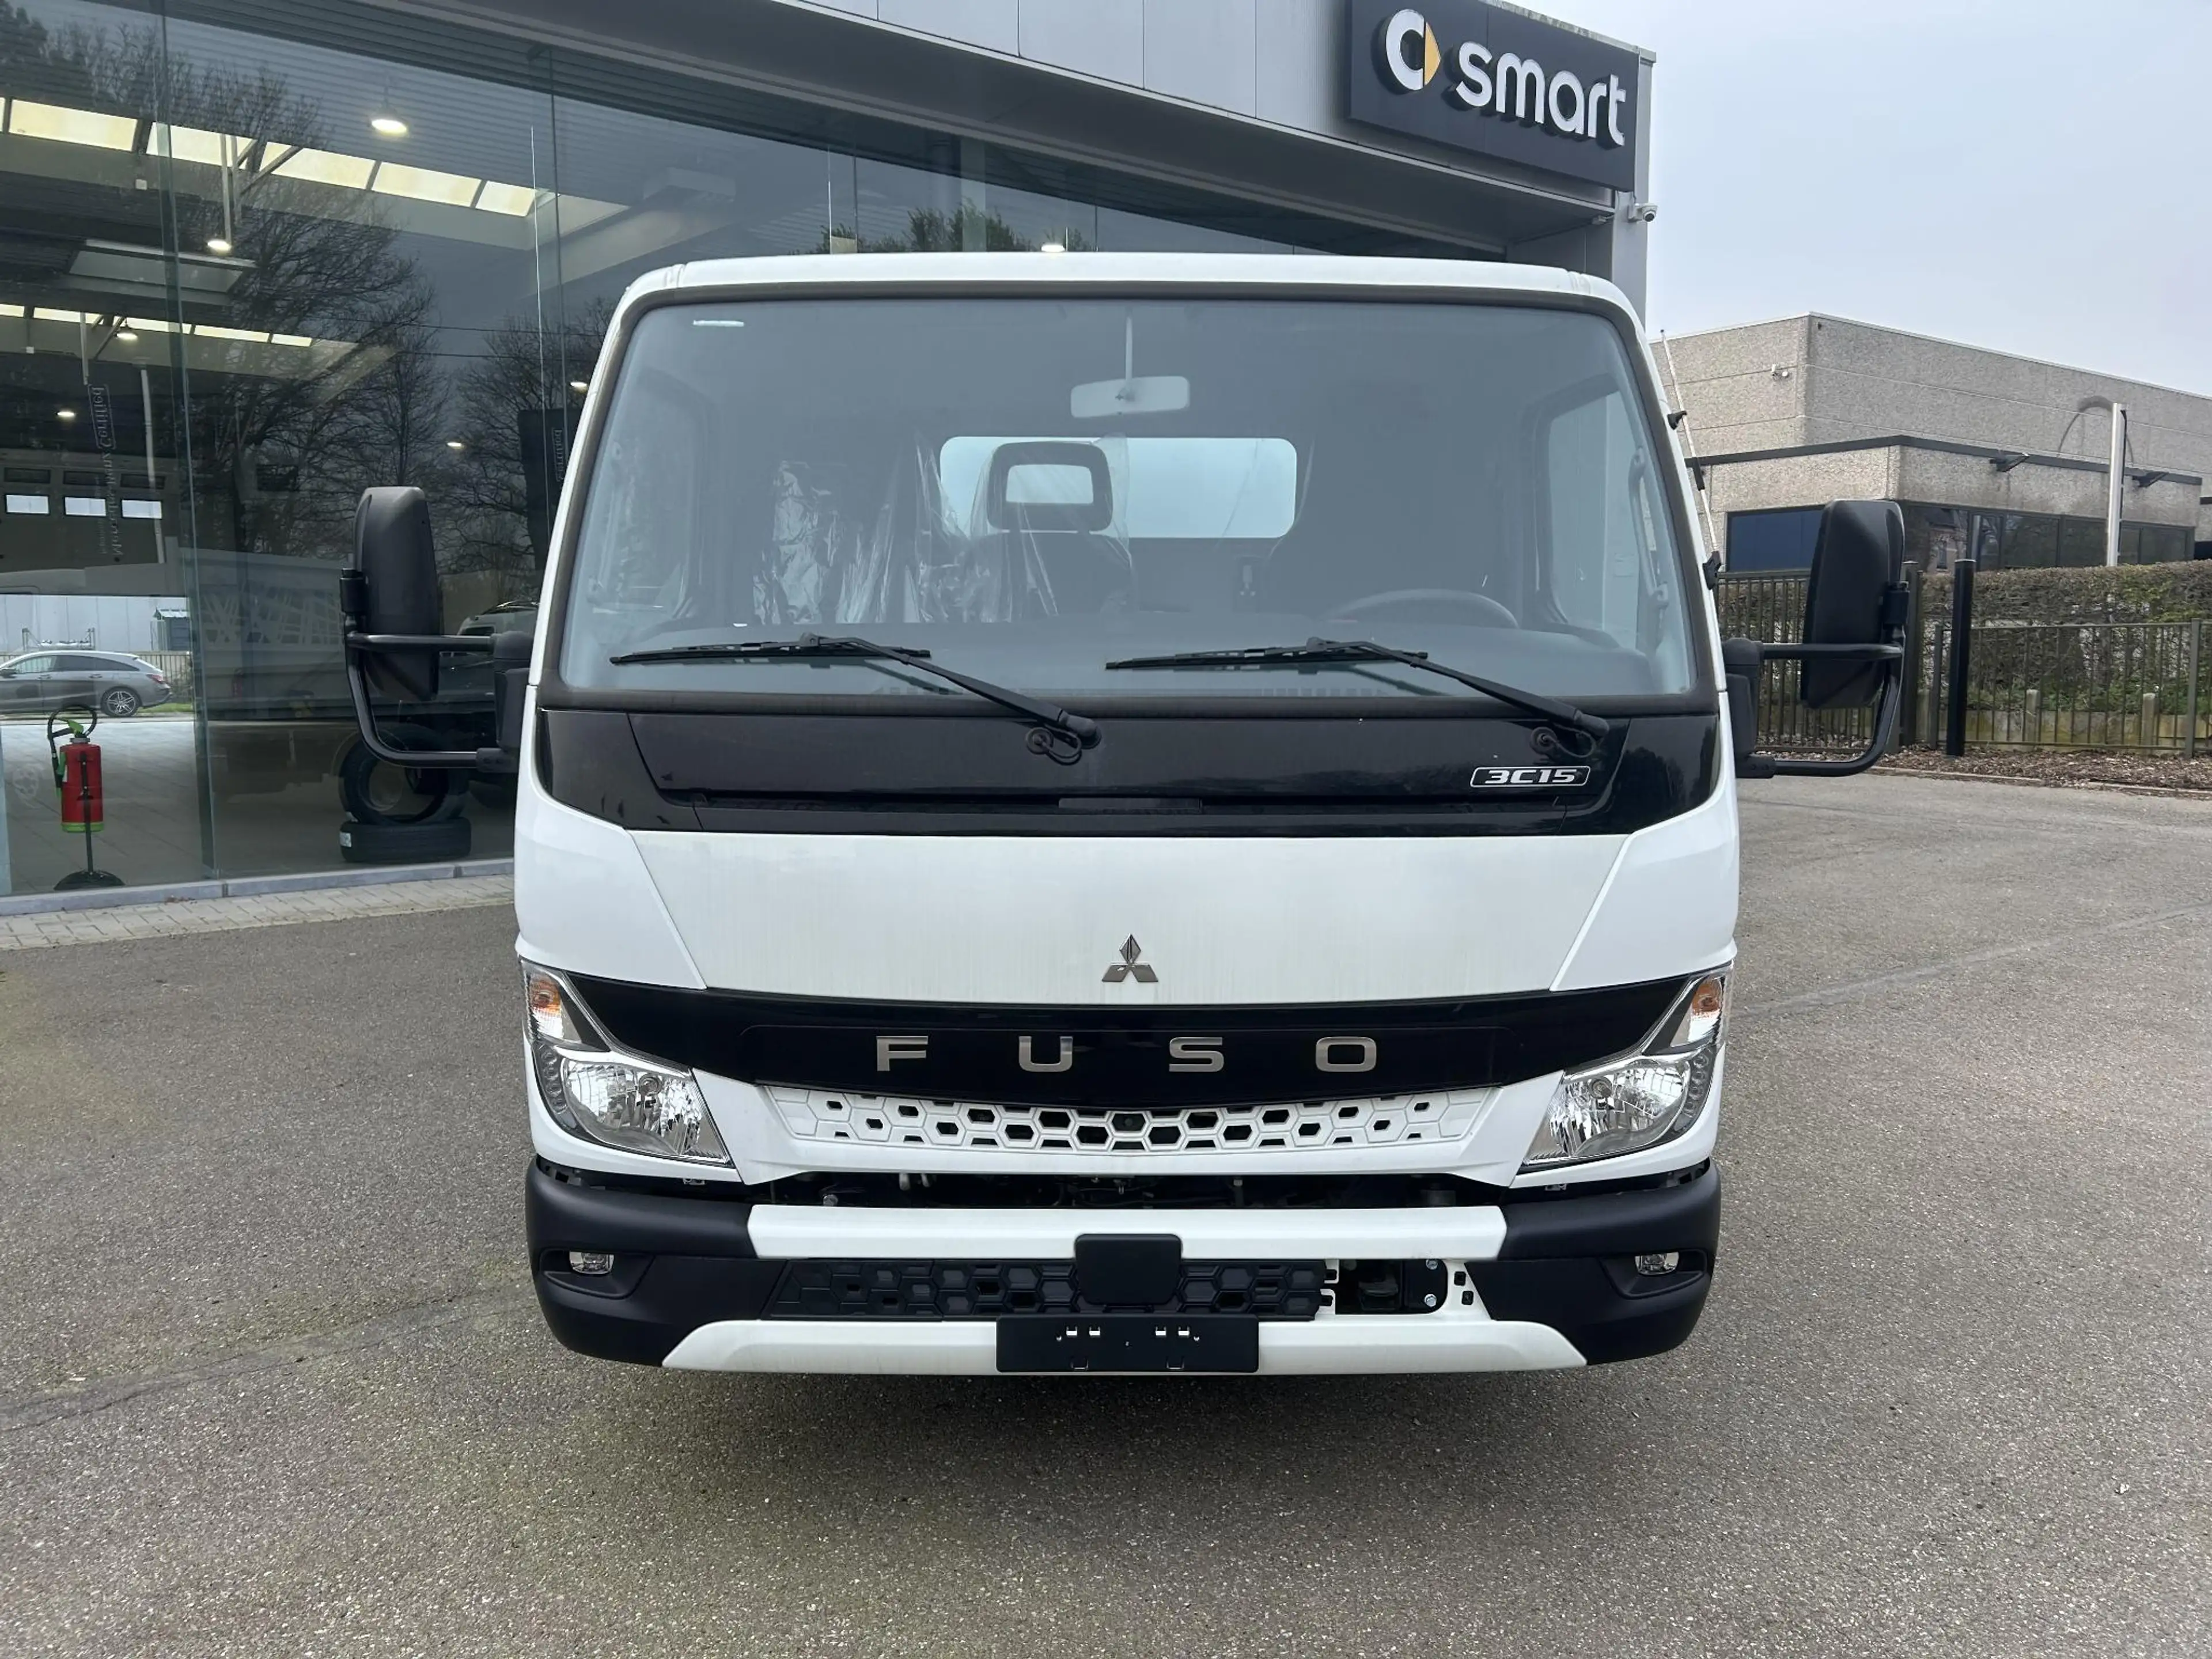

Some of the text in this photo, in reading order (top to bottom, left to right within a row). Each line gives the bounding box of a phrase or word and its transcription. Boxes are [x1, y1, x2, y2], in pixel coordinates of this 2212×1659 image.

[1456, 41, 1626, 146] smart
[1484, 769, 1577, 784] 3C15
[876, 1036, 1377, 1073] FUSO
